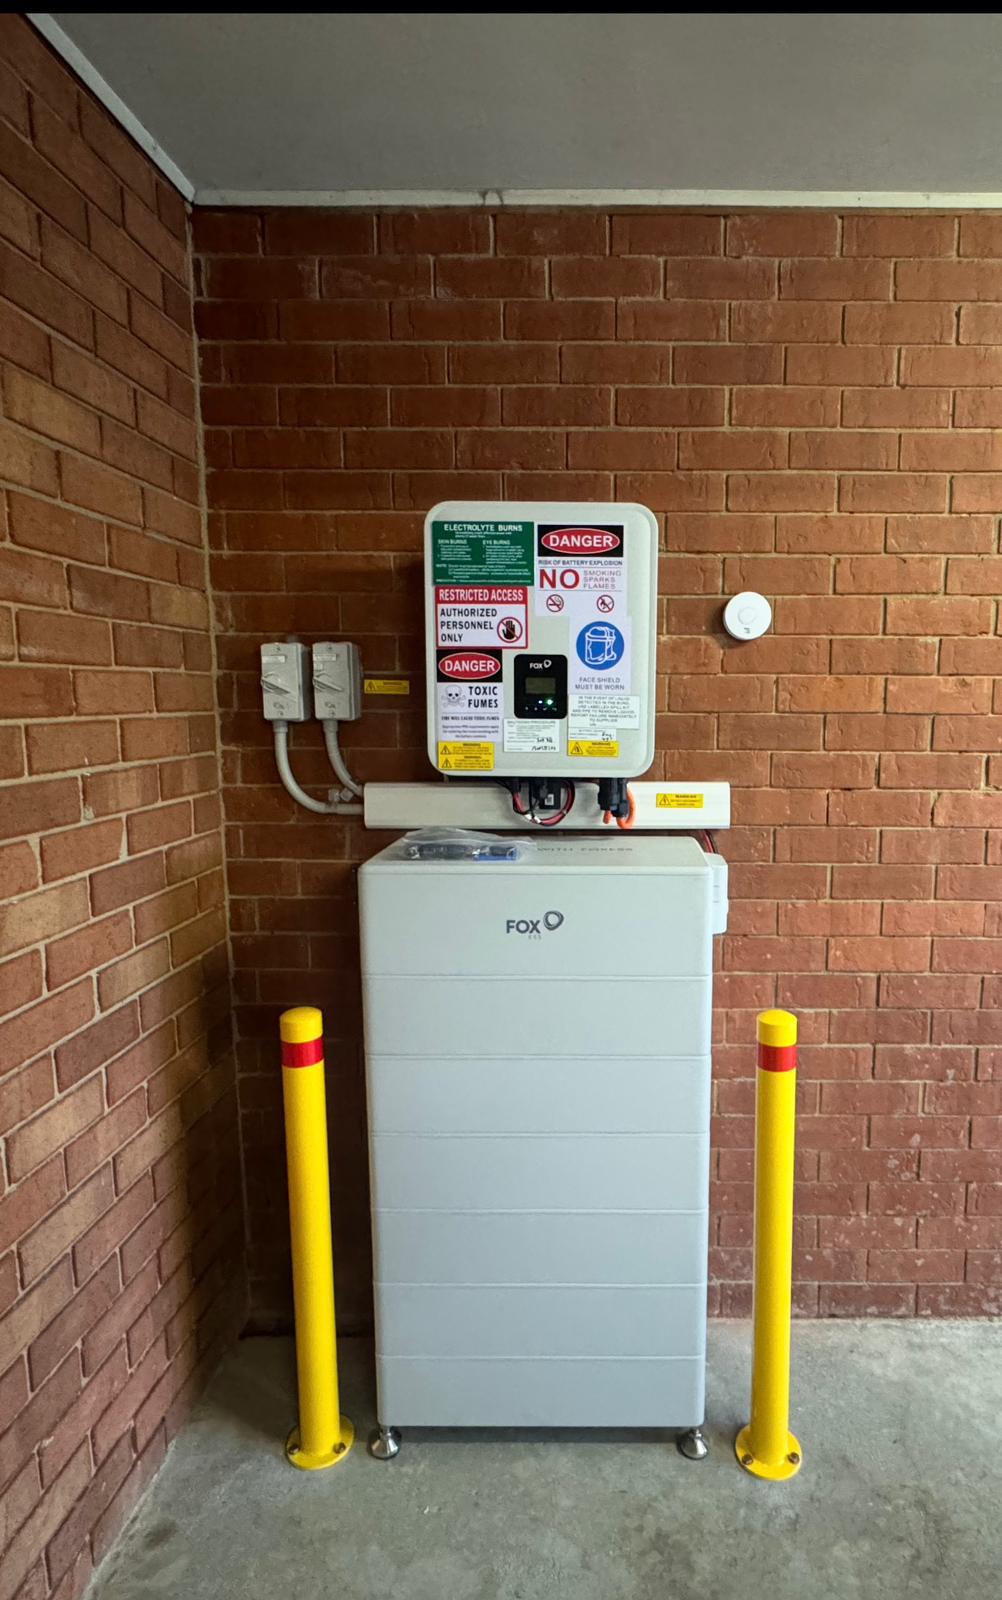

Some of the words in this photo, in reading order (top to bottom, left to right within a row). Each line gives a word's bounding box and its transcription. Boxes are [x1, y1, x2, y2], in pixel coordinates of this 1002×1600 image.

[550, 535, 613, 548] DANGER
[540, 569, 580, 589] NO
[439, 589, 490, 600] RESTRICTED
[491, 589, 523, 601] ACCESS
[440, 608, 497, 617] AUTHORIZED
[440, 621, 493, 630] PERSONNEL
[441, 633, 463, 642] ONLY
[444, 660, 496, 672] DANGER
[468, 686, 498, 696] TOXIC
[468, 699, 498, 708] FUMES
[506, 920, 541, 934] FOX
